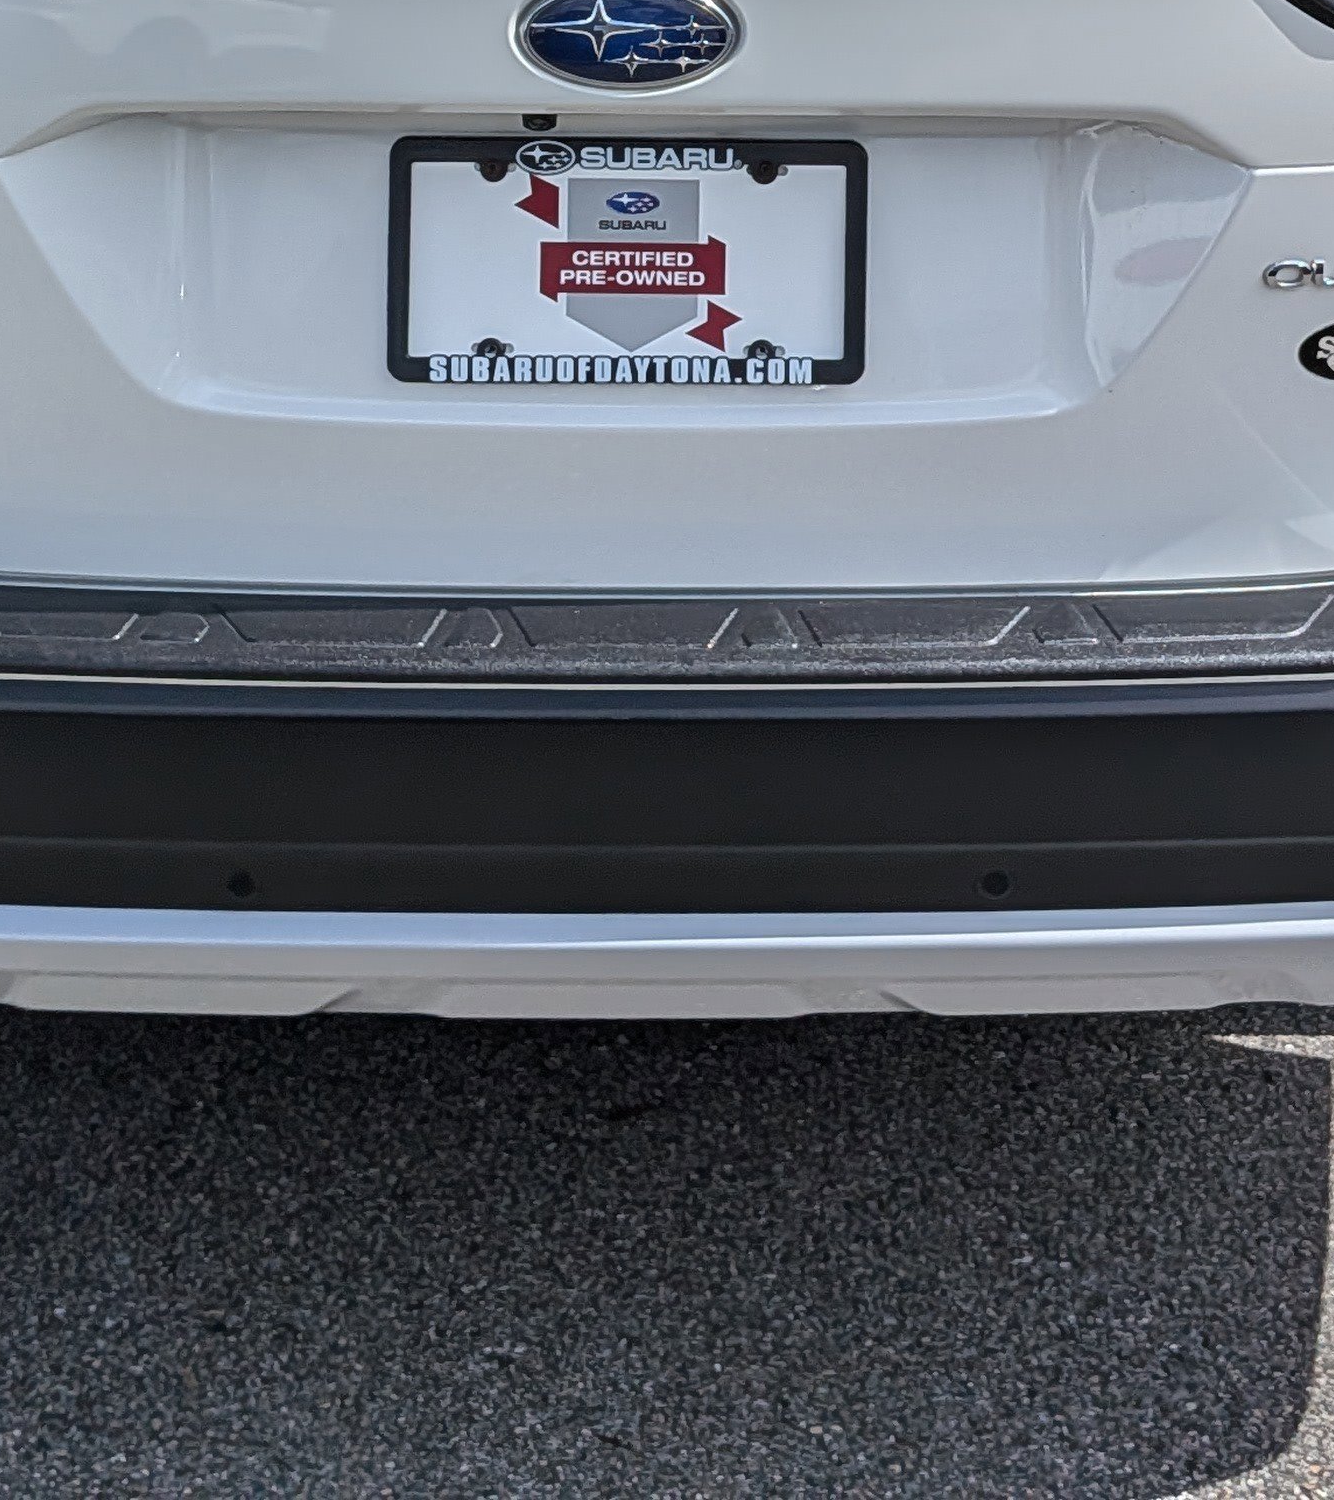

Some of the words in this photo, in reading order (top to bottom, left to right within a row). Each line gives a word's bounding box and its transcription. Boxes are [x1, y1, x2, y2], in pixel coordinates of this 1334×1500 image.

[579, 146, 735, 171] SUBARU
[598, 219, 666, 231] SUBARU
[571, 249, 694, 267] CERTIFIED
[559, 269, 706, 287] PRE-OWNED
[429, 355, 813, 384] SUBARUOFDAYTONA.COM
